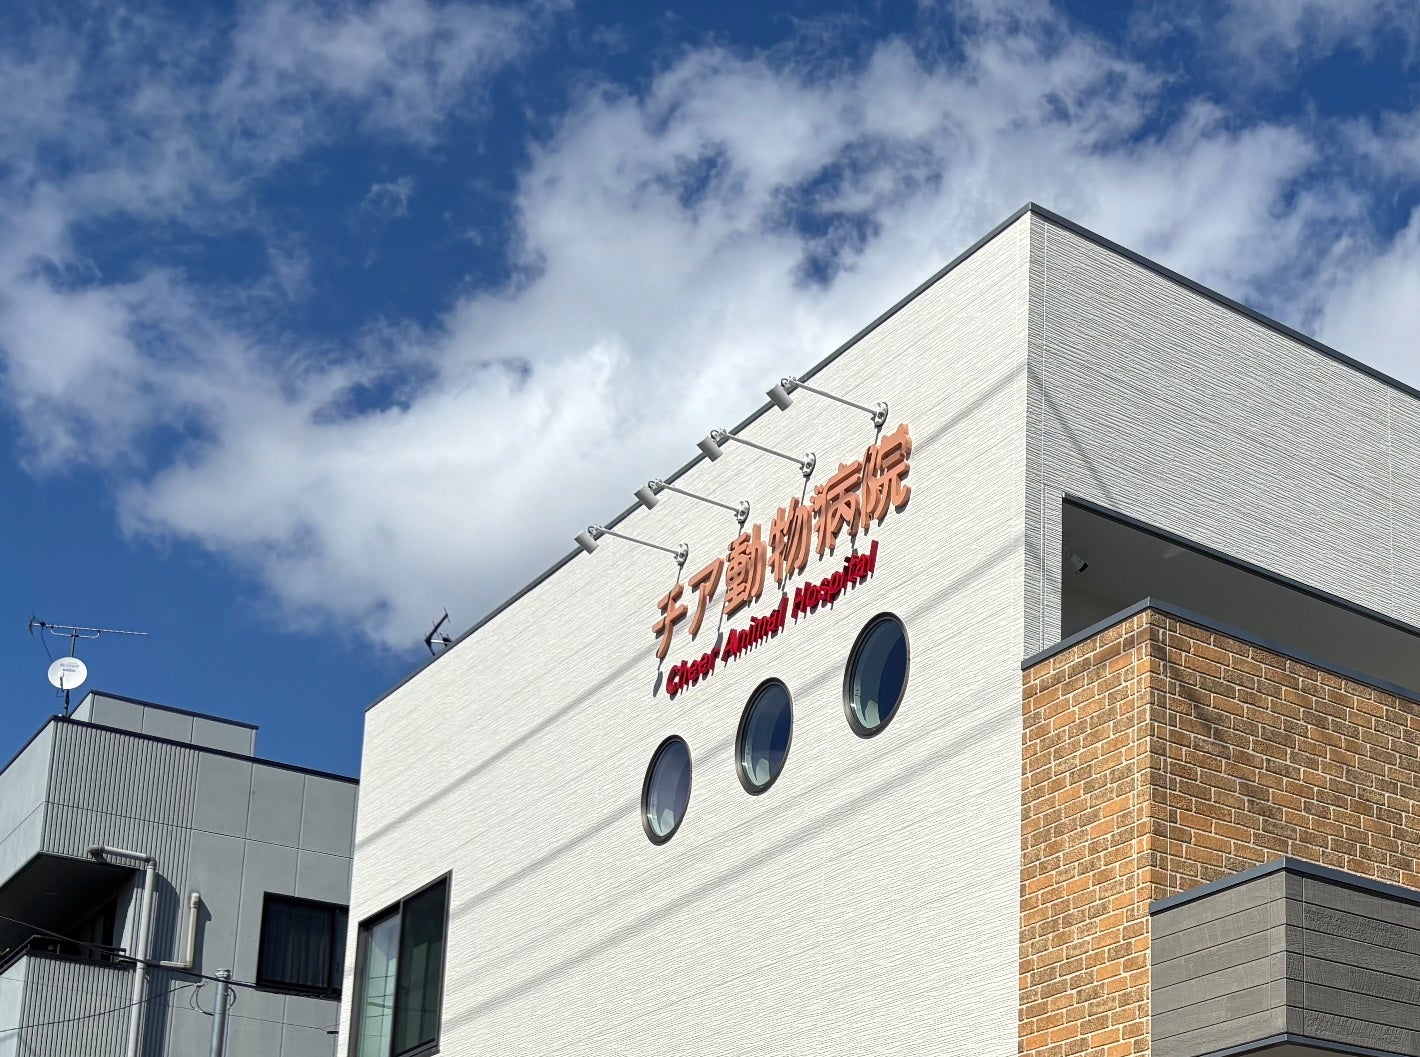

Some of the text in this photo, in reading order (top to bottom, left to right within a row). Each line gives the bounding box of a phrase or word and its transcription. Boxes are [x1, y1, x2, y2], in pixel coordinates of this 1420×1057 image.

[651, 423, 912, 660] チア動物病院
[666, 540, 879, 695] Cheer Animal Hospital
